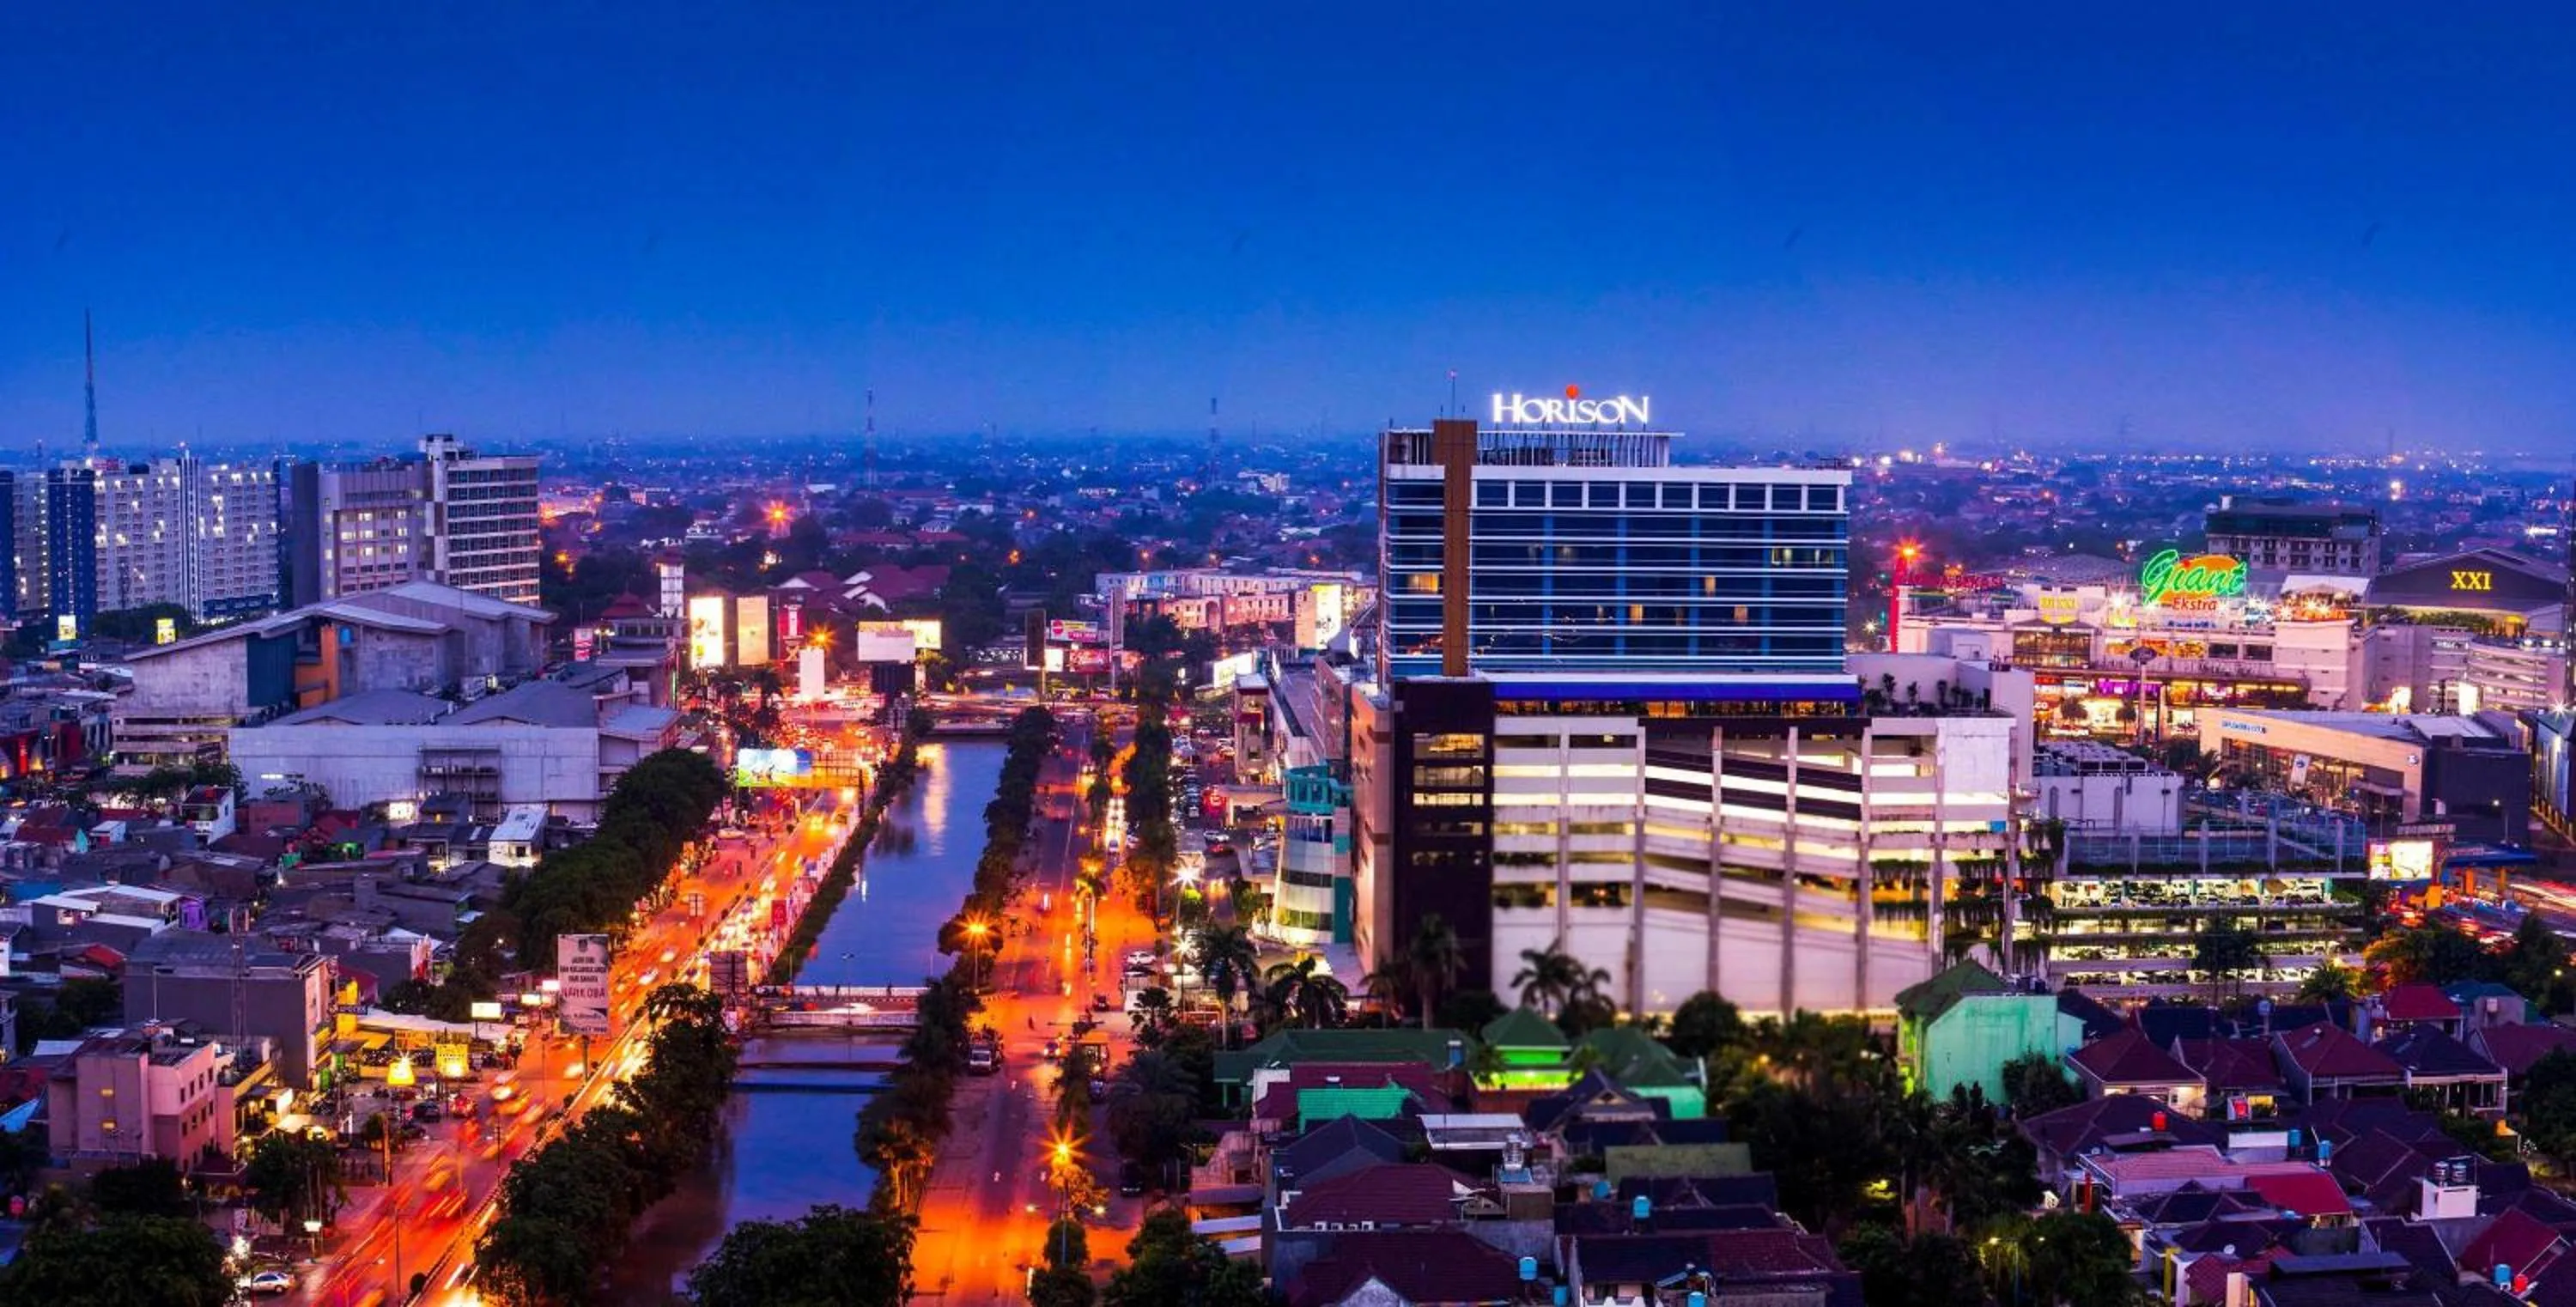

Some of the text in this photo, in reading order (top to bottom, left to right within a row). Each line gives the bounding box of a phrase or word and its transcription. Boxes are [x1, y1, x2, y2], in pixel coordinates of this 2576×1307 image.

[2143, 549, 2247, 605] Giant
[2451, 571, 2493, 590] XXI
[2172, 597, 2219, 611] Ekstra
